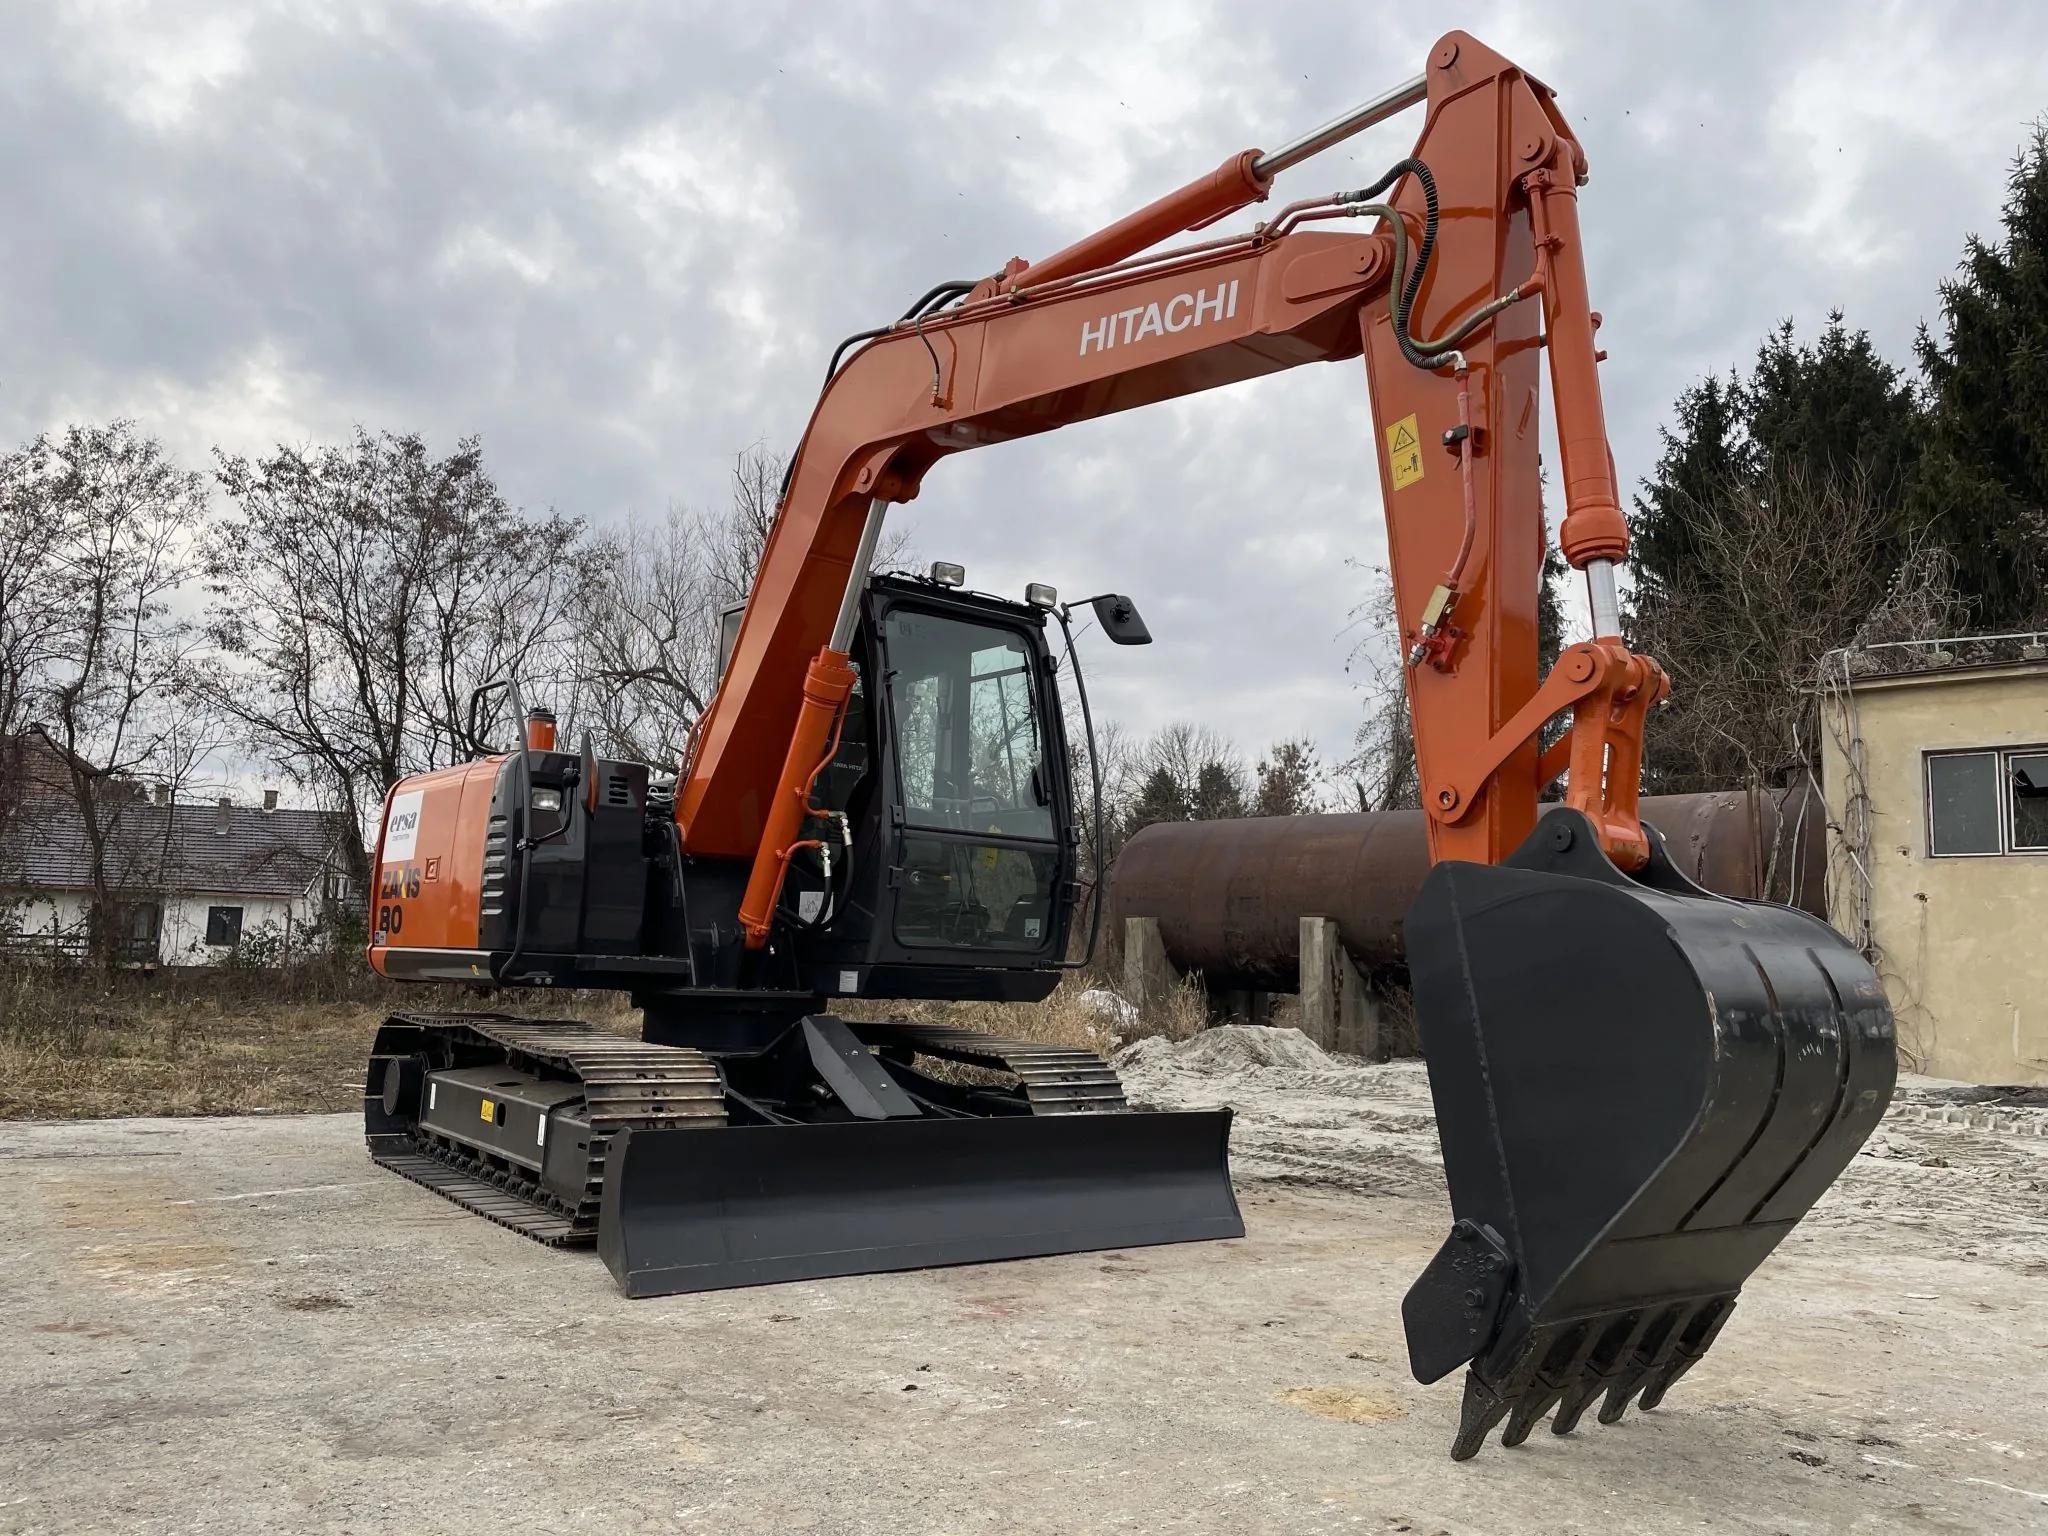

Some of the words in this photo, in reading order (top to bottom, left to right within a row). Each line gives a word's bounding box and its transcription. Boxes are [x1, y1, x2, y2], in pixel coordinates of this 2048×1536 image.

[1080, 280, 1239, 356] HITACHI
[390, 811, 417, 832] ersa
[381, 864, 421, 899] ZAXIS
[380, 905, 402, 934] 80
